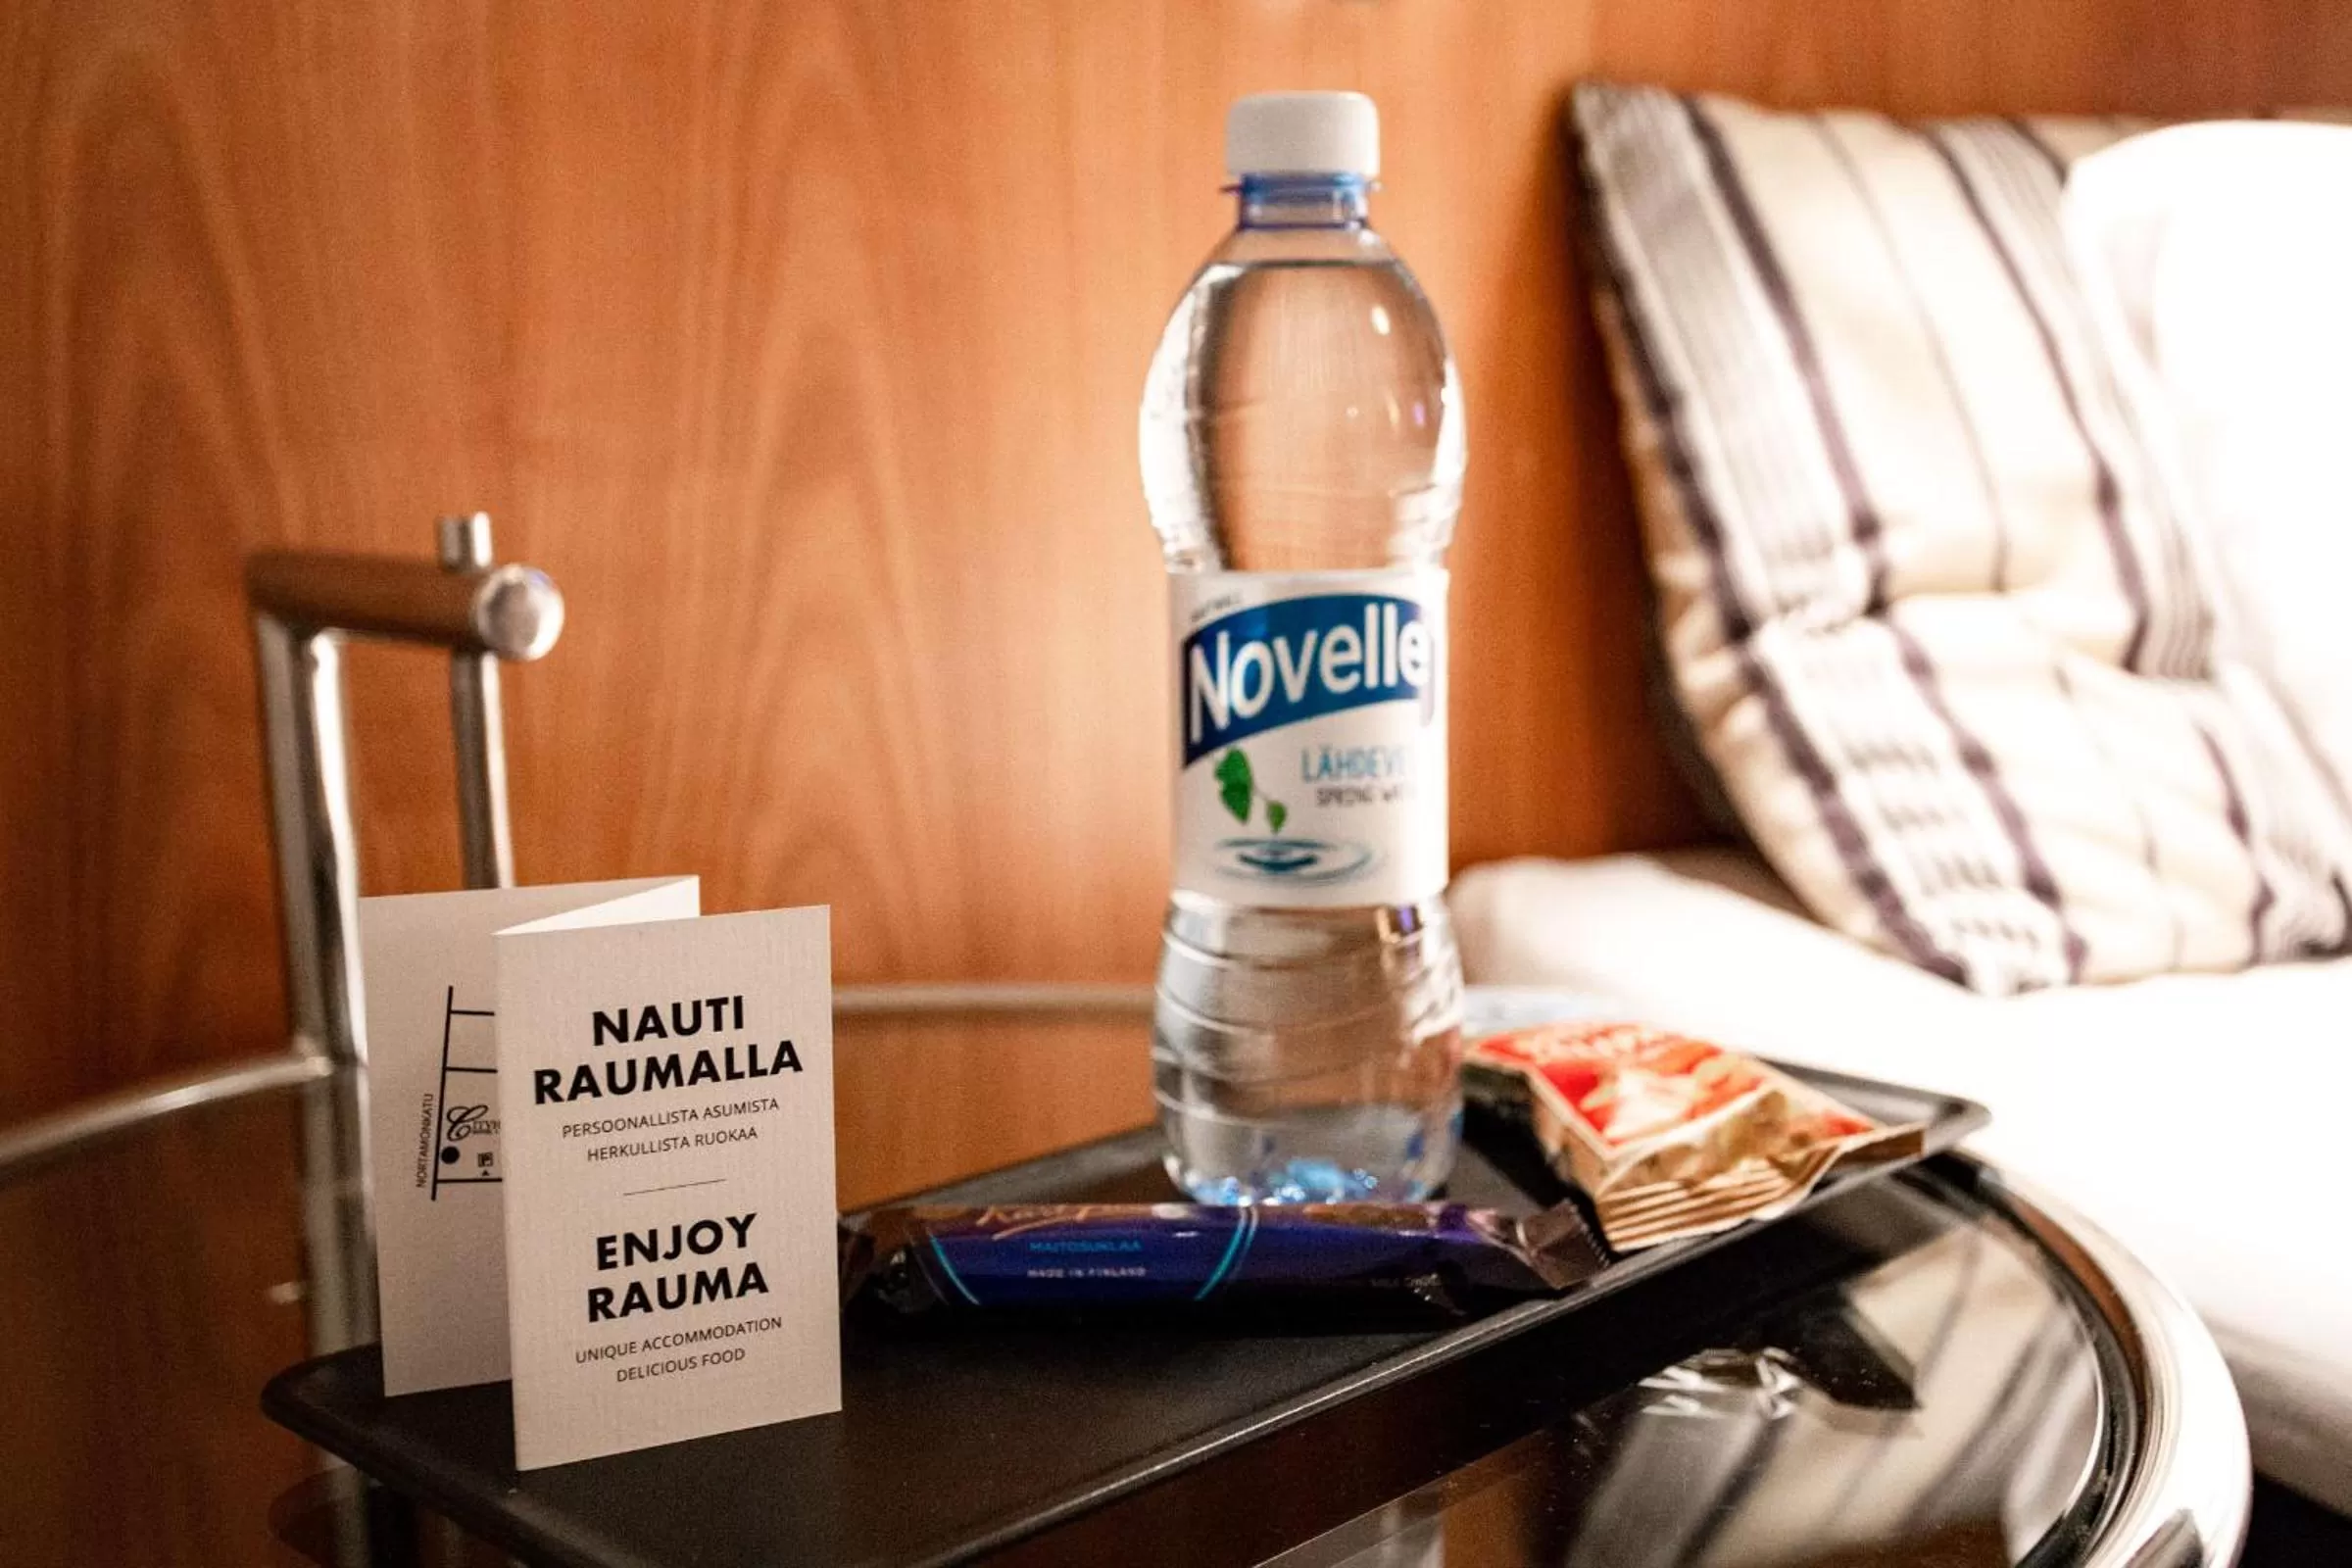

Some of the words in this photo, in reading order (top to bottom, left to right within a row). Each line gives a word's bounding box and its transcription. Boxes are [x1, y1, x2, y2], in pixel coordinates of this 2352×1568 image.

[1190, 602, 1433, 744] Novelle
[592, 995, 744, 1047] NAUTI
[533, 1040, 804, 1105] RAUMALLA
[416, 1093, 434, 1189] NORTAMONKATU
[562, 1108, 699, 1139] PERSOONALLISTA
[703, 1098, 780, 1120] ASUMISTA
[587, 1137, 690, 1161] HERKULLISTA
[694, 1127, 759, 1148] RUOKAA
[597, 1212, 758, 1271] ENJOY
[588, 1262, 769, 1323] RAUMA
[575, 1341, 637, 1364] UNIQUE
[642, 1317, 782, 1352] ACCOMMODATION
[616, 1356, 698, 1383] DELICIOUS
[702, 1348, 746, 1366] FOOD
